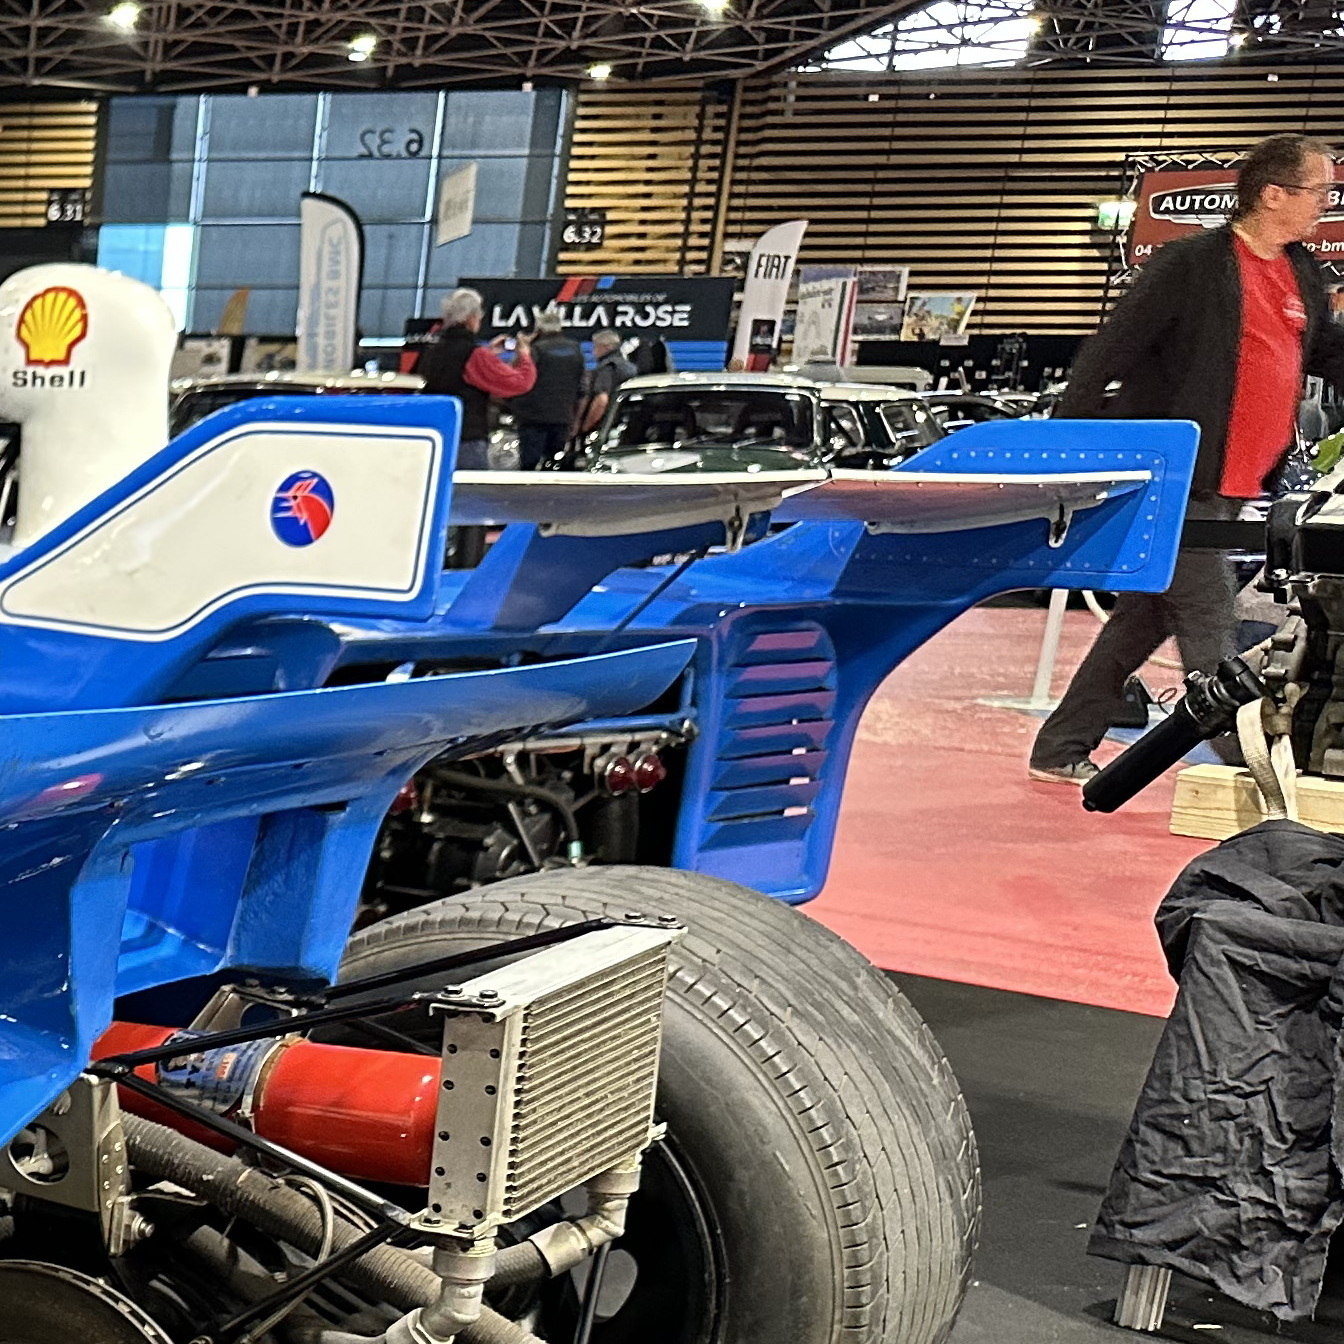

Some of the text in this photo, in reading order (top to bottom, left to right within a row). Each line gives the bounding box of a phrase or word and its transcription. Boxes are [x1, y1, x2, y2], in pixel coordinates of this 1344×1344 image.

[46, 203, 84, 222] 6.31
[562, 223, 602, 244] 6.32
[753, 253, 792, 281] FIAT
[491, 303, 529, 328] LA
[614, 303, 692, 328] ROSE
[12, 369, 86, 388] Shell
